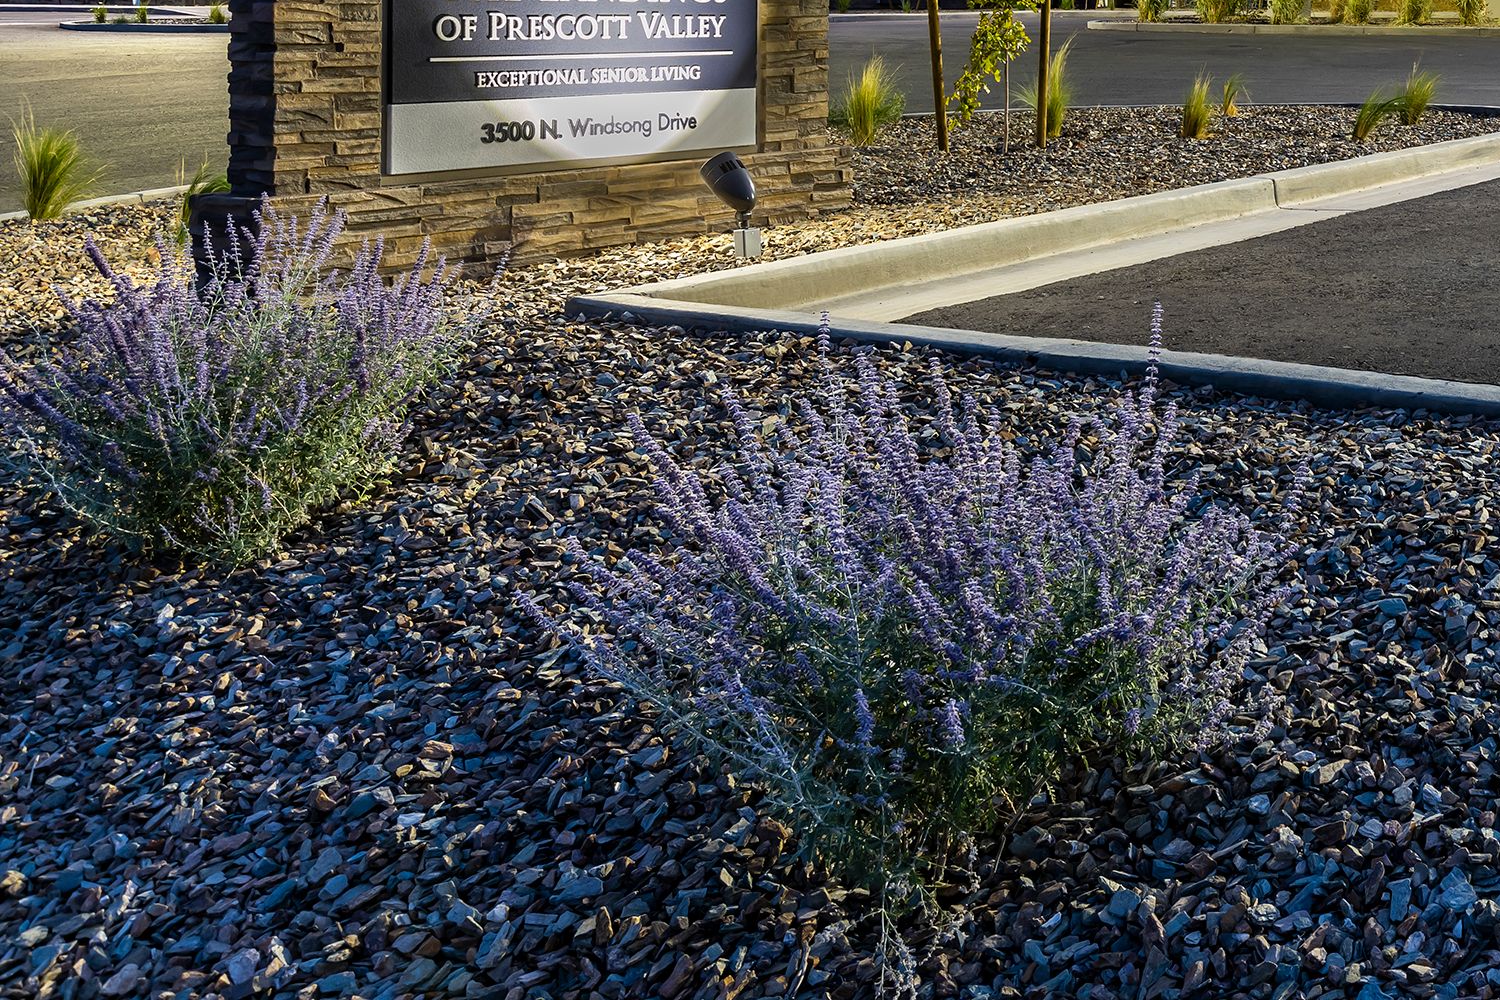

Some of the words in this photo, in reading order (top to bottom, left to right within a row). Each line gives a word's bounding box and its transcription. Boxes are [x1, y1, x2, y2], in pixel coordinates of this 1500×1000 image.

[435, 14, 477, 41] OF
[488, 12, 631, 40] PRESCOTT
[637, 11, 726, 39] VALLEY
[476, 69, 588, 88] EXCEPTIONAL
[591, 67, 648, 84] SENIOR
[650, 65, 701, 81] LIVING
[480, 121, 535, 144] 3500
[540, 119, 562, 140] N.
[568, 116, 652, 137] Windsong
[658, 112, 697, 131] Drive
